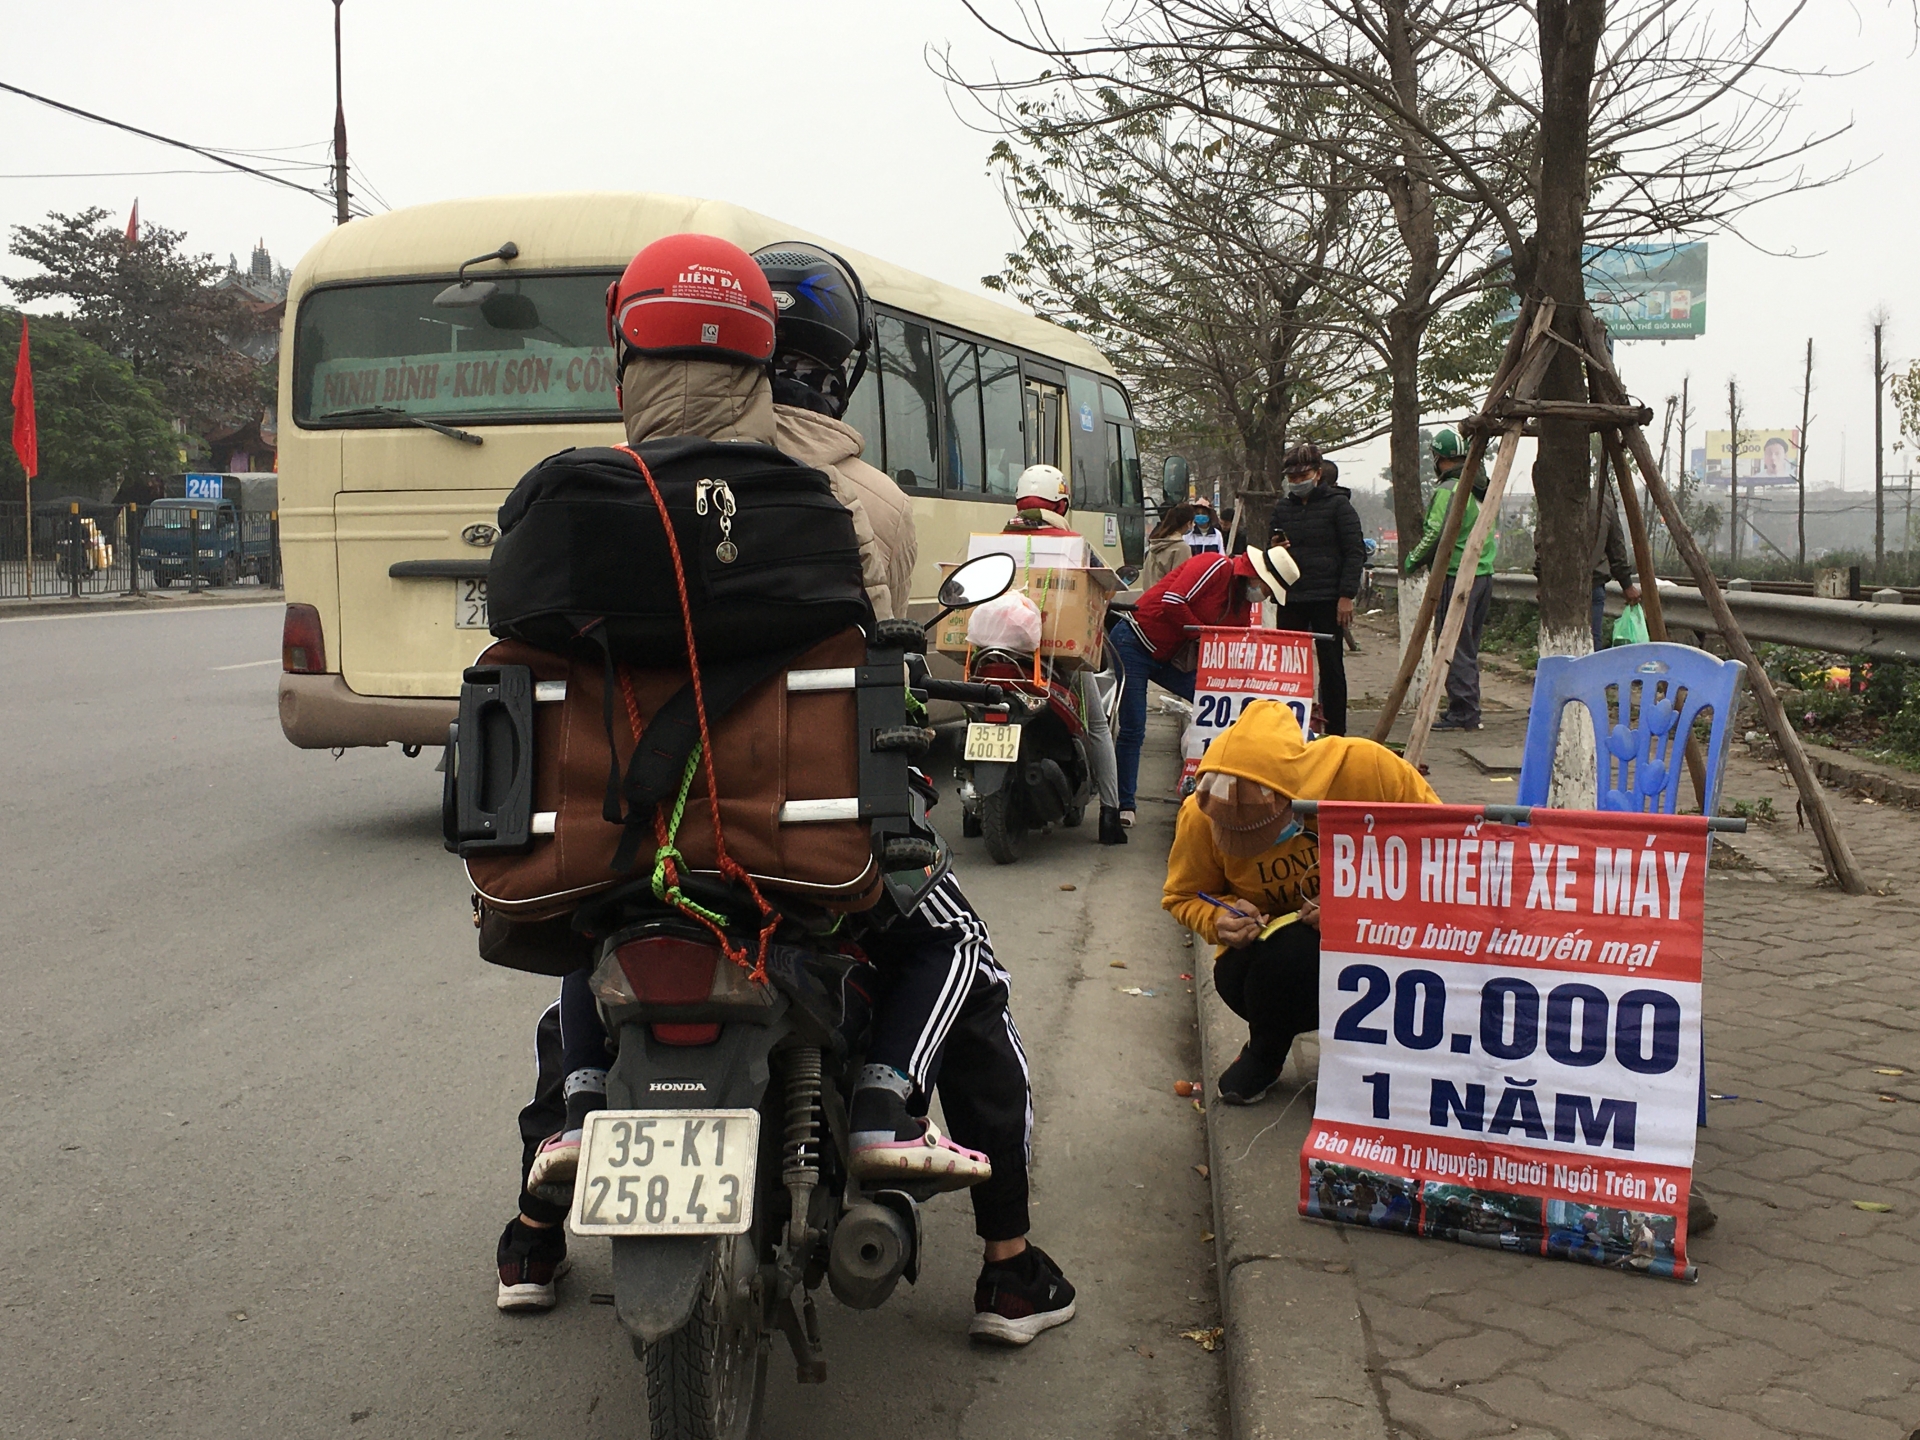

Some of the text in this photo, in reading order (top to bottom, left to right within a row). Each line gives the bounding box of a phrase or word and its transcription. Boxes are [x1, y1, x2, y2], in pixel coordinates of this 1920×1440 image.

[678, 272, 715, 285] LIÊN
[720, 278, 742, 291] ĐÁ
[698, 265, 733, 276] HONDA
[382, 358, 440, 402] BÌNH
[453, 360, 499, 398] KIM
[503, 354, 553, 395] SƠN
[188, 479, 220, 499] 24h
[1201, 633, 1308, 674] BẢO HIỂM XE MÁY
[968, 743, 1014, 759] 400.12
[975, 726, 1012, 742] 35-B1
[1333, 813, 1690, 920] BẢO HIỂM XE MÁY
[1356, 918, 1660, 972] Tưng bừng khuyến mại
[1334, 963, 1681, 1075] 20.000
[650, 1083, 706, 1091] HONDA
[1362, 1071, 1637, 1151] 1 NĂM
[608, 1119, 727, 1168] 35-K1
[1313, 1131, 1677, 1204] Bảo Hiểm Tự Nguyện Người Ngồi Trên Xe
[586, 1174, 740, 1225] 258.43
